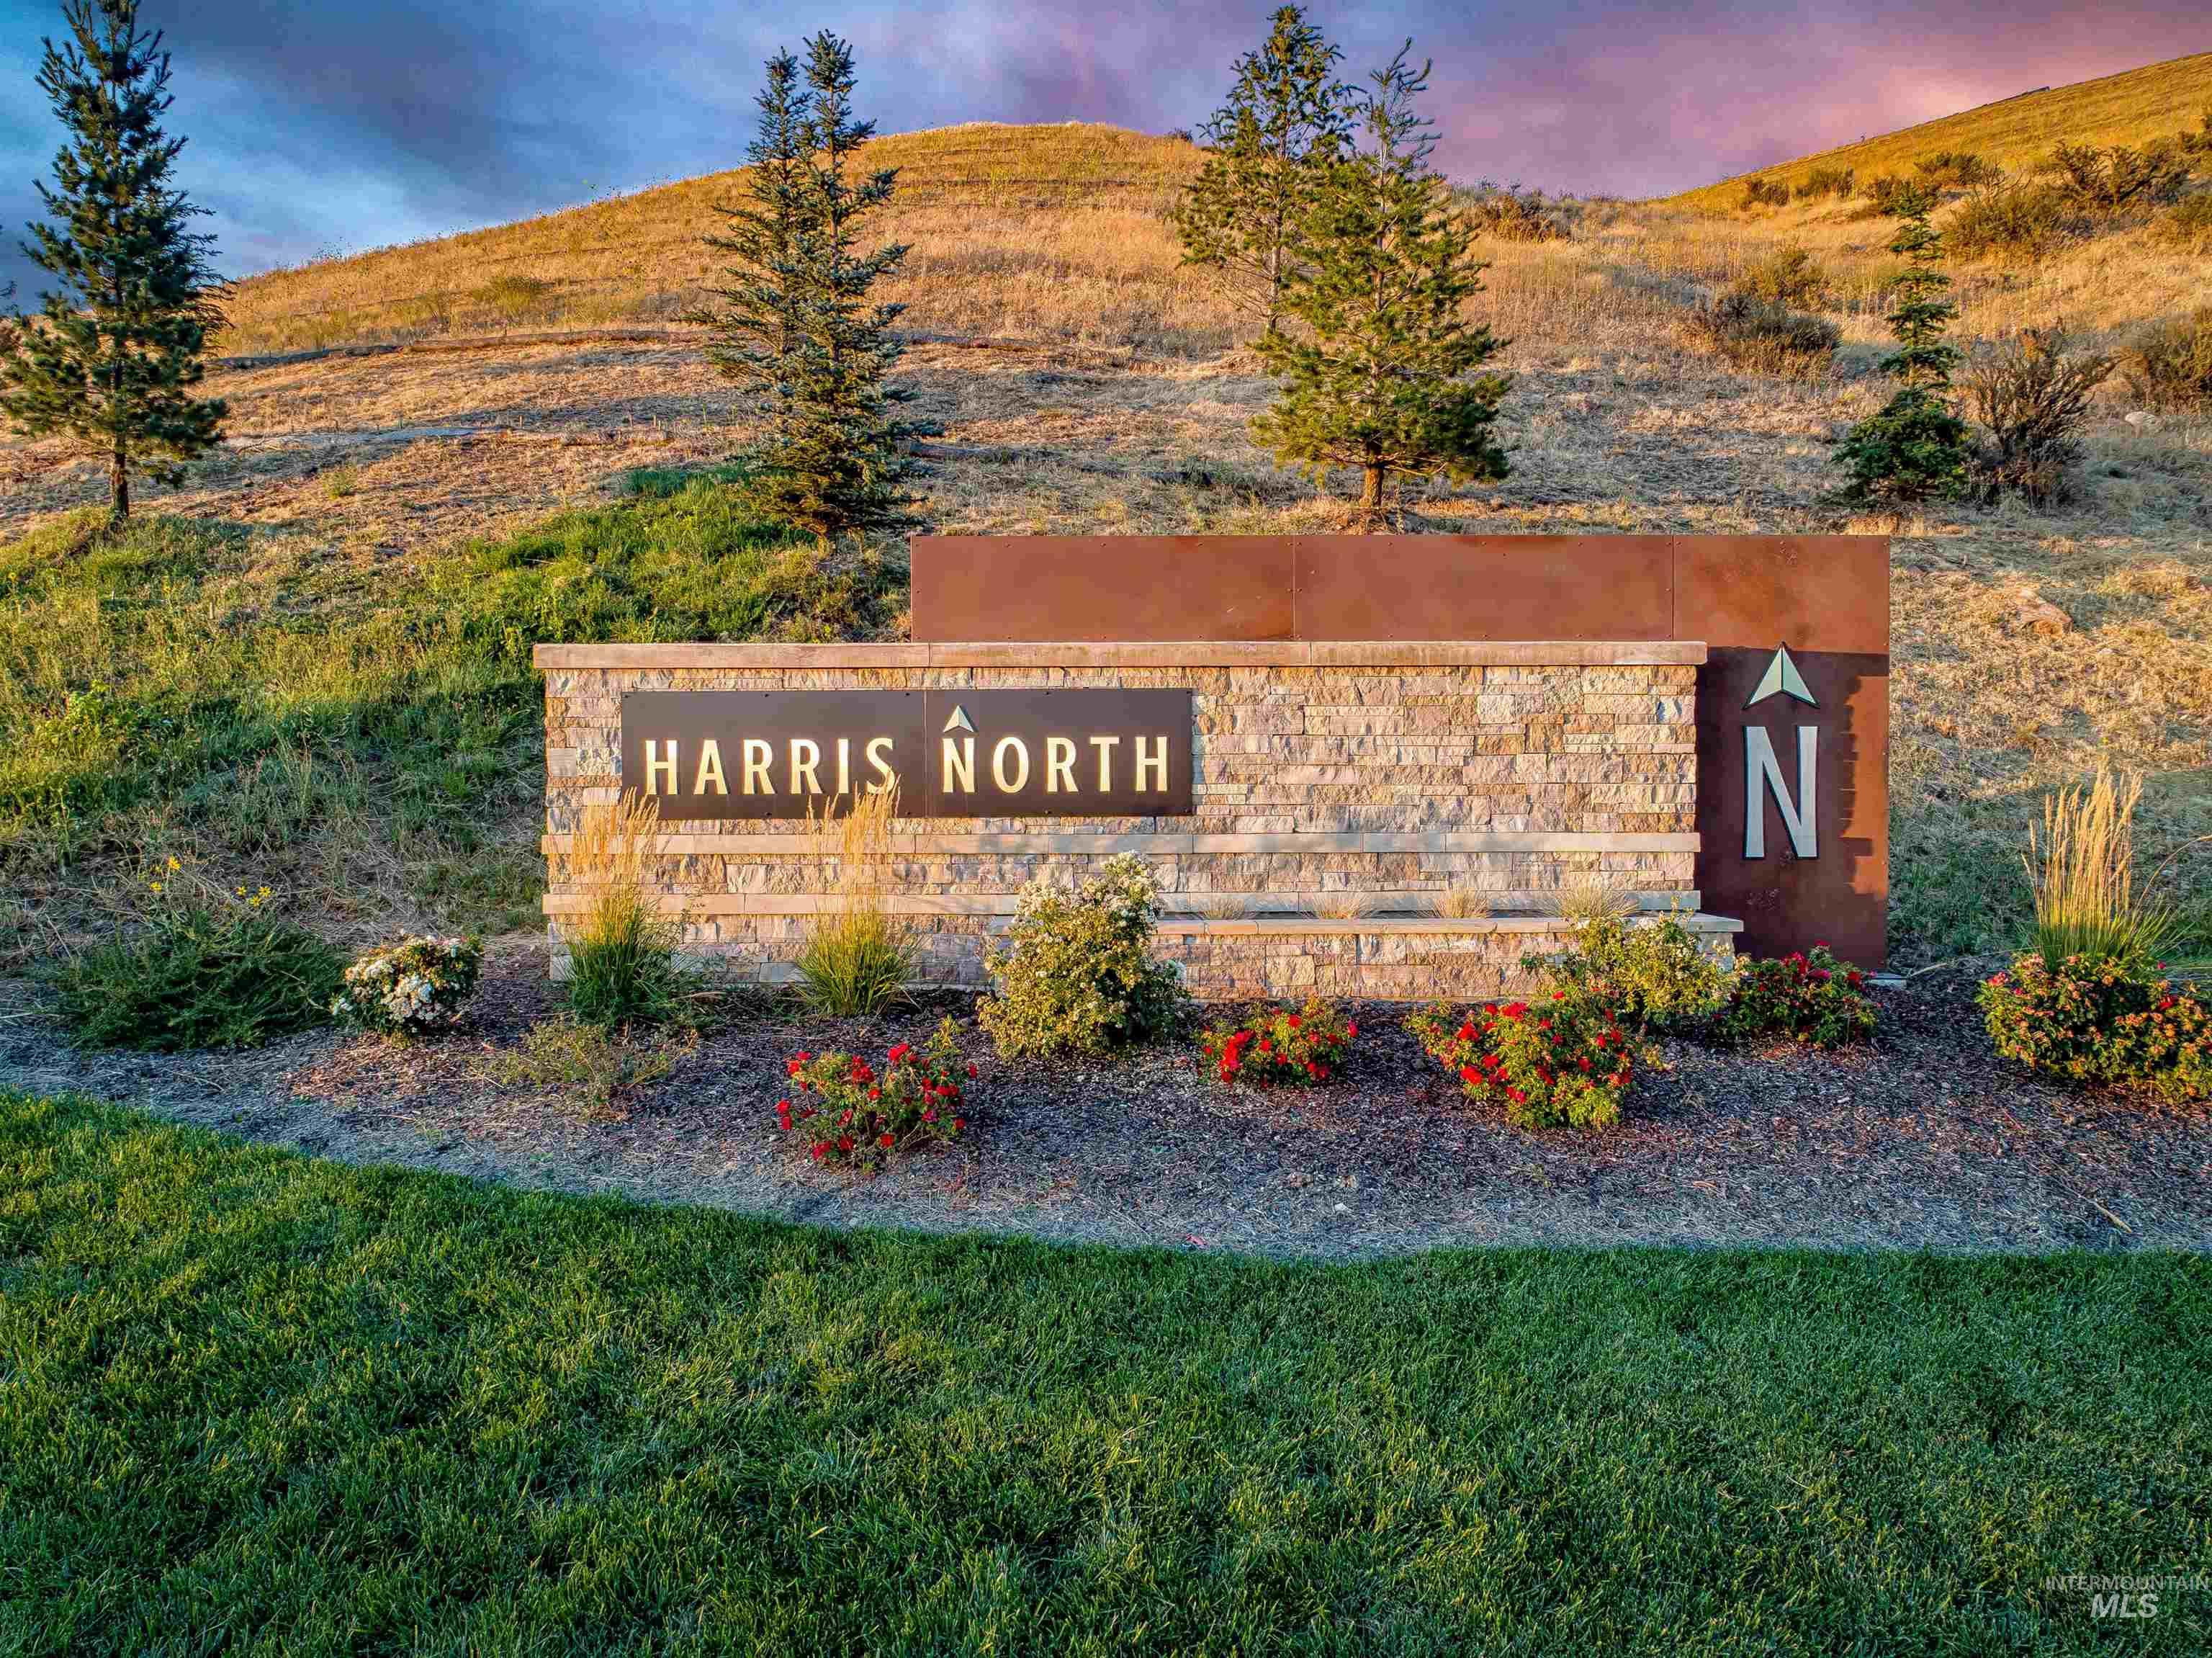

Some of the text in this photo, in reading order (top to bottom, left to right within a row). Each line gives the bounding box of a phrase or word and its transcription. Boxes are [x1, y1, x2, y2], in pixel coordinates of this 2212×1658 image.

[645, 735, 1169, 795] HARRIS NORTH
[1745, 726, 1818, 859] N
